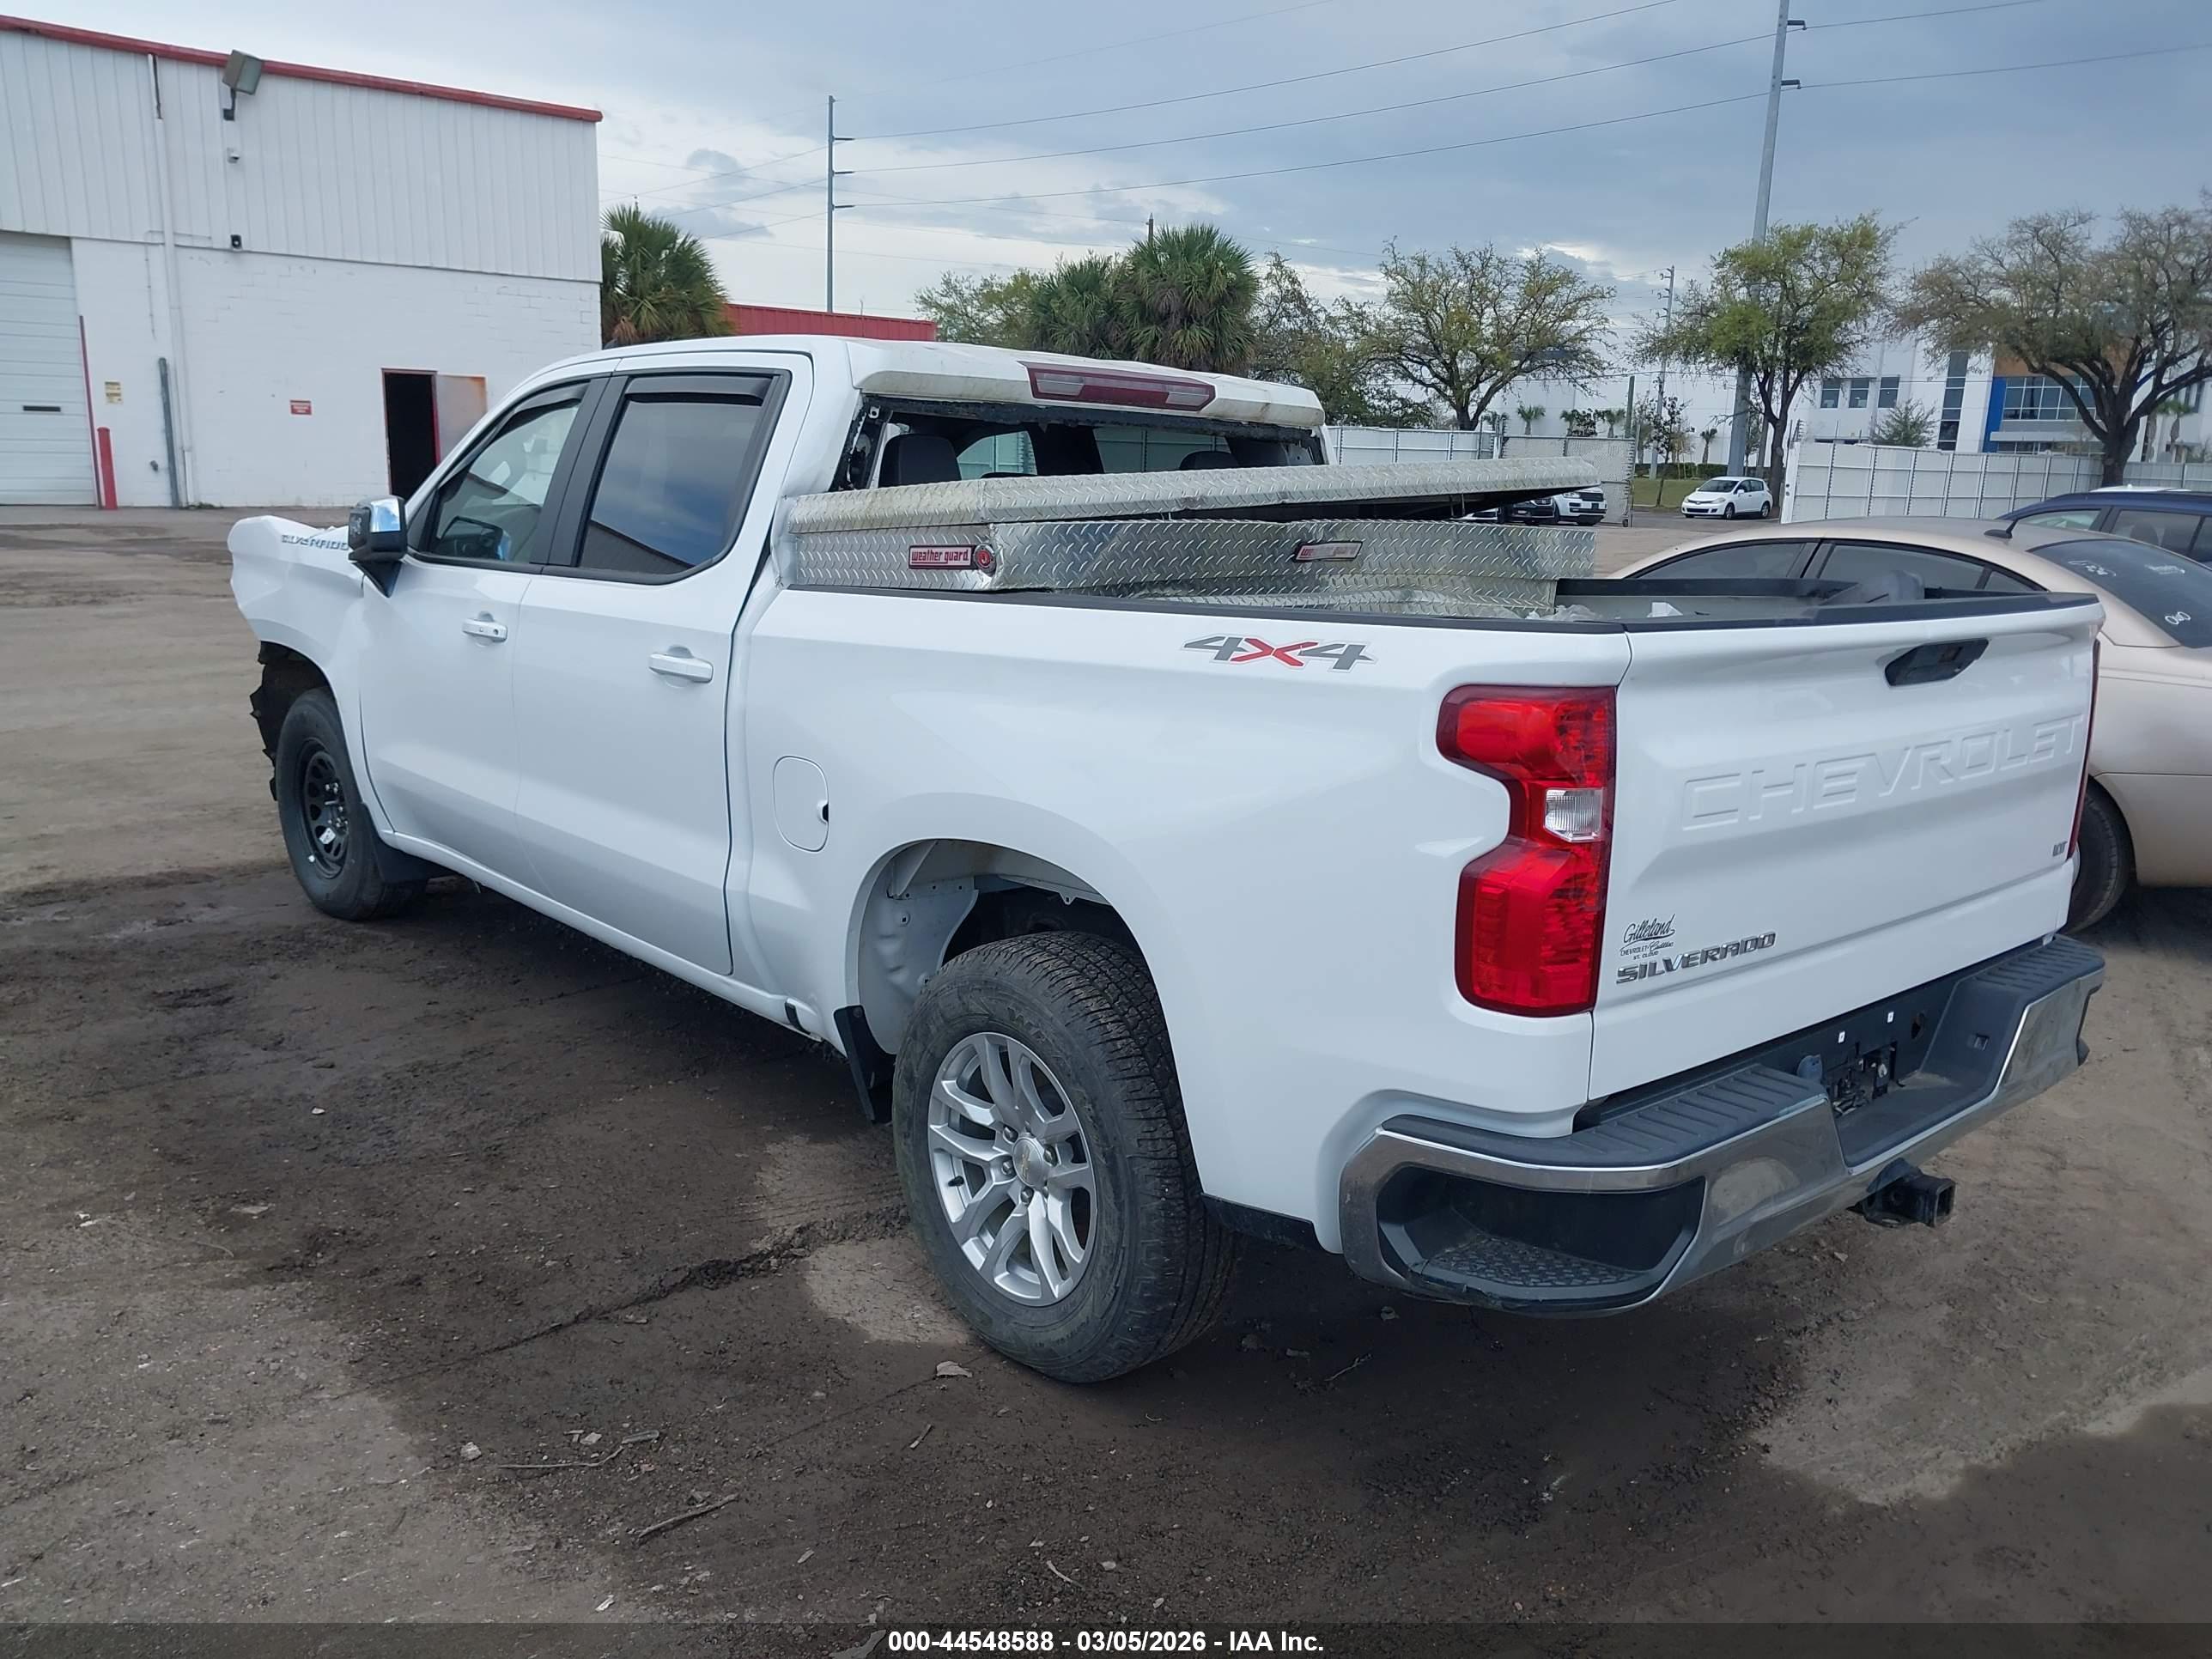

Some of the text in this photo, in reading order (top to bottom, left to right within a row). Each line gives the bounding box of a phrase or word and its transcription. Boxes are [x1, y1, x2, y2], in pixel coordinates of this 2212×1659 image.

[912, 550, 943, 562] weather
[1681, 714, 2084, 831] CHEVROLET
[1623, 913, 1675, 943] Gilleland
[1616, 932, 1776, 984] SILVERADO
